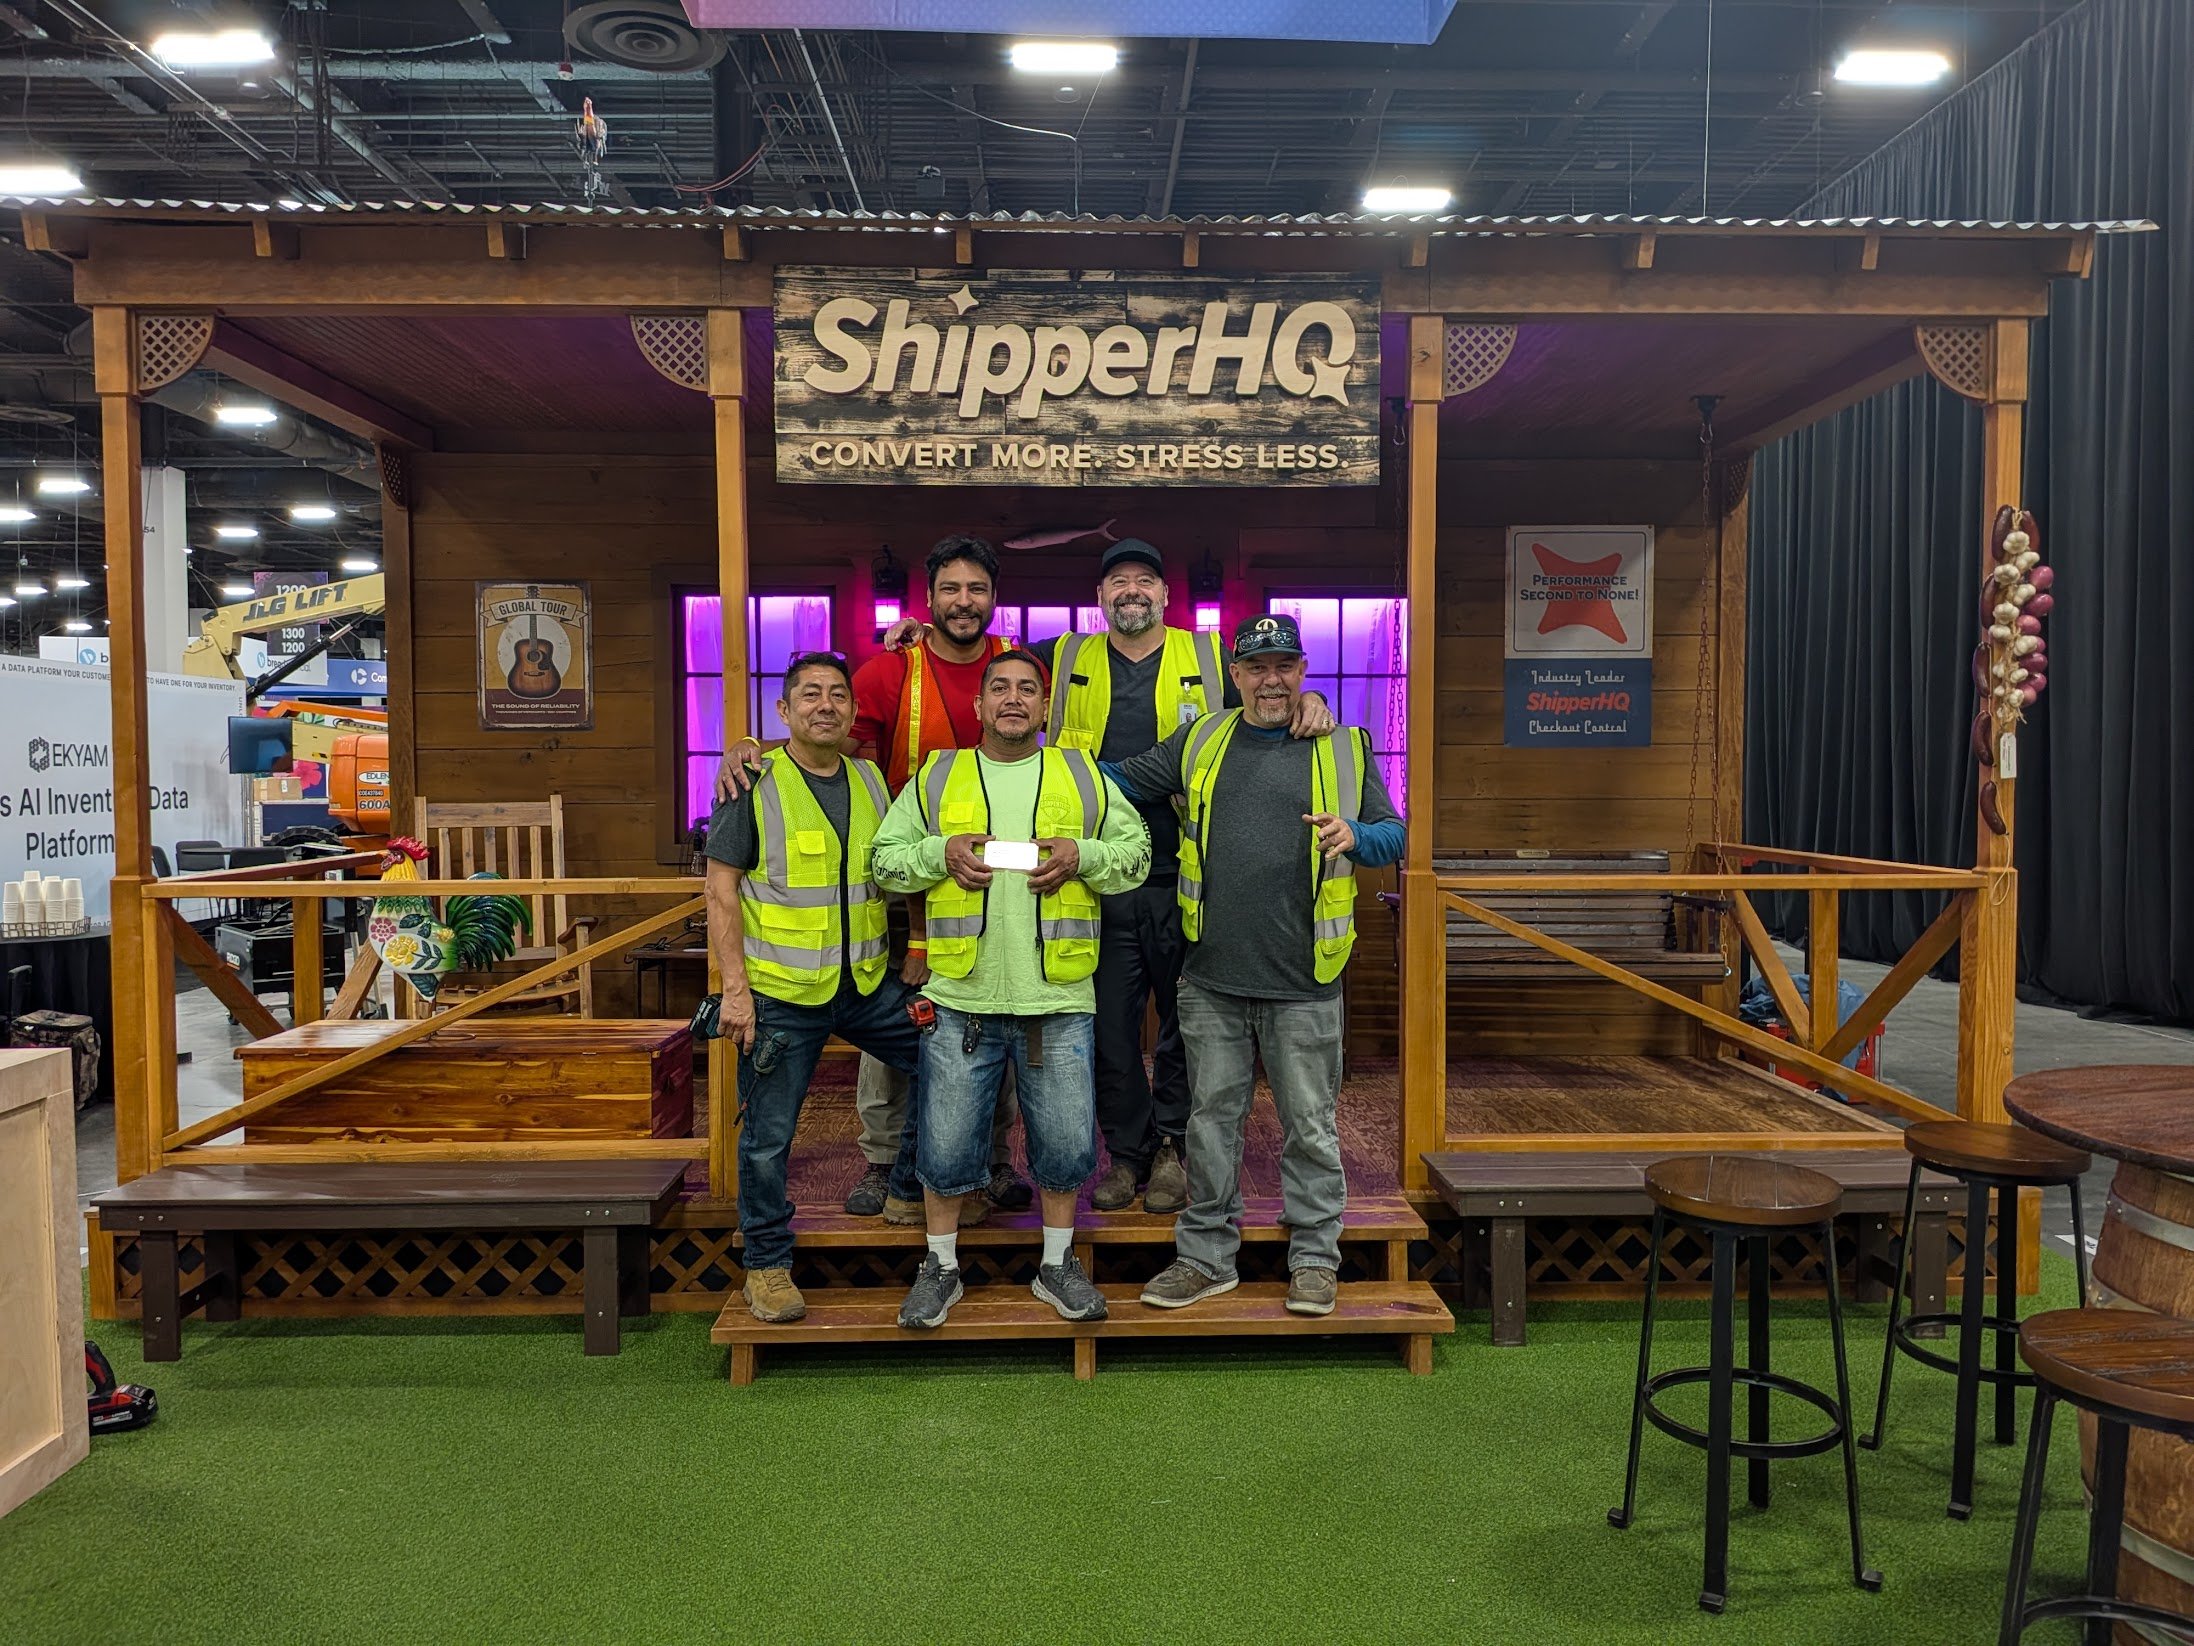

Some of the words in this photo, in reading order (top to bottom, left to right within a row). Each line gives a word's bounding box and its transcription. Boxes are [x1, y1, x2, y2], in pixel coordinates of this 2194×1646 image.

[803, 284, 1356, 418] ShipperHQ
[810, 441, 977, 469] CONVERT
[991, 443, 1103, 470] MORE.
[1116, 444, 1244, 470] STRESS
[1256, 444, 1350, 470] LESS.
[242, 597, 287, 623] JLG
[295, 582, 349, 611] LIFT
[498, 601, 537, 616] GLOBAL
[540, 601, 567, 616] TOUR
[281, 627, 305, 639] 1300
[281, 641, 305, 654] 1200
[1, 663, 7, 671] A
[8, 664, 26, 673] DATA
[27, 665, 62, 676] PLATFORM
[64, 669, 80, 678] YOUR
[82, 671, 111, 681] CUSTOME
[1531, 670, 1581, 686] Industry
[1585, 670, 1625, 685] Leader
[155, 678, 169, 687] HAVE
[170, 679, 181, 687] ONE
[182, 680, 193, 688] FOR
[194, 681, 207, 689] YOUR
[208, 682, 235, 691] INVENTORY
[1527, 688, 1630, 715] ShipperHQ
[1529, 720, 1581, 735] Checkout
[1585, 720, 1627, 735] Control
[52, 743, 109, 767] EKYAM
[19, 787, 41, 816] AI
[48, 787, 113, 815] Invent
[149, 785, 189, 811] Data
[359, 800, 390, 810] 600A
[26, 828, 115, 861] Platform
